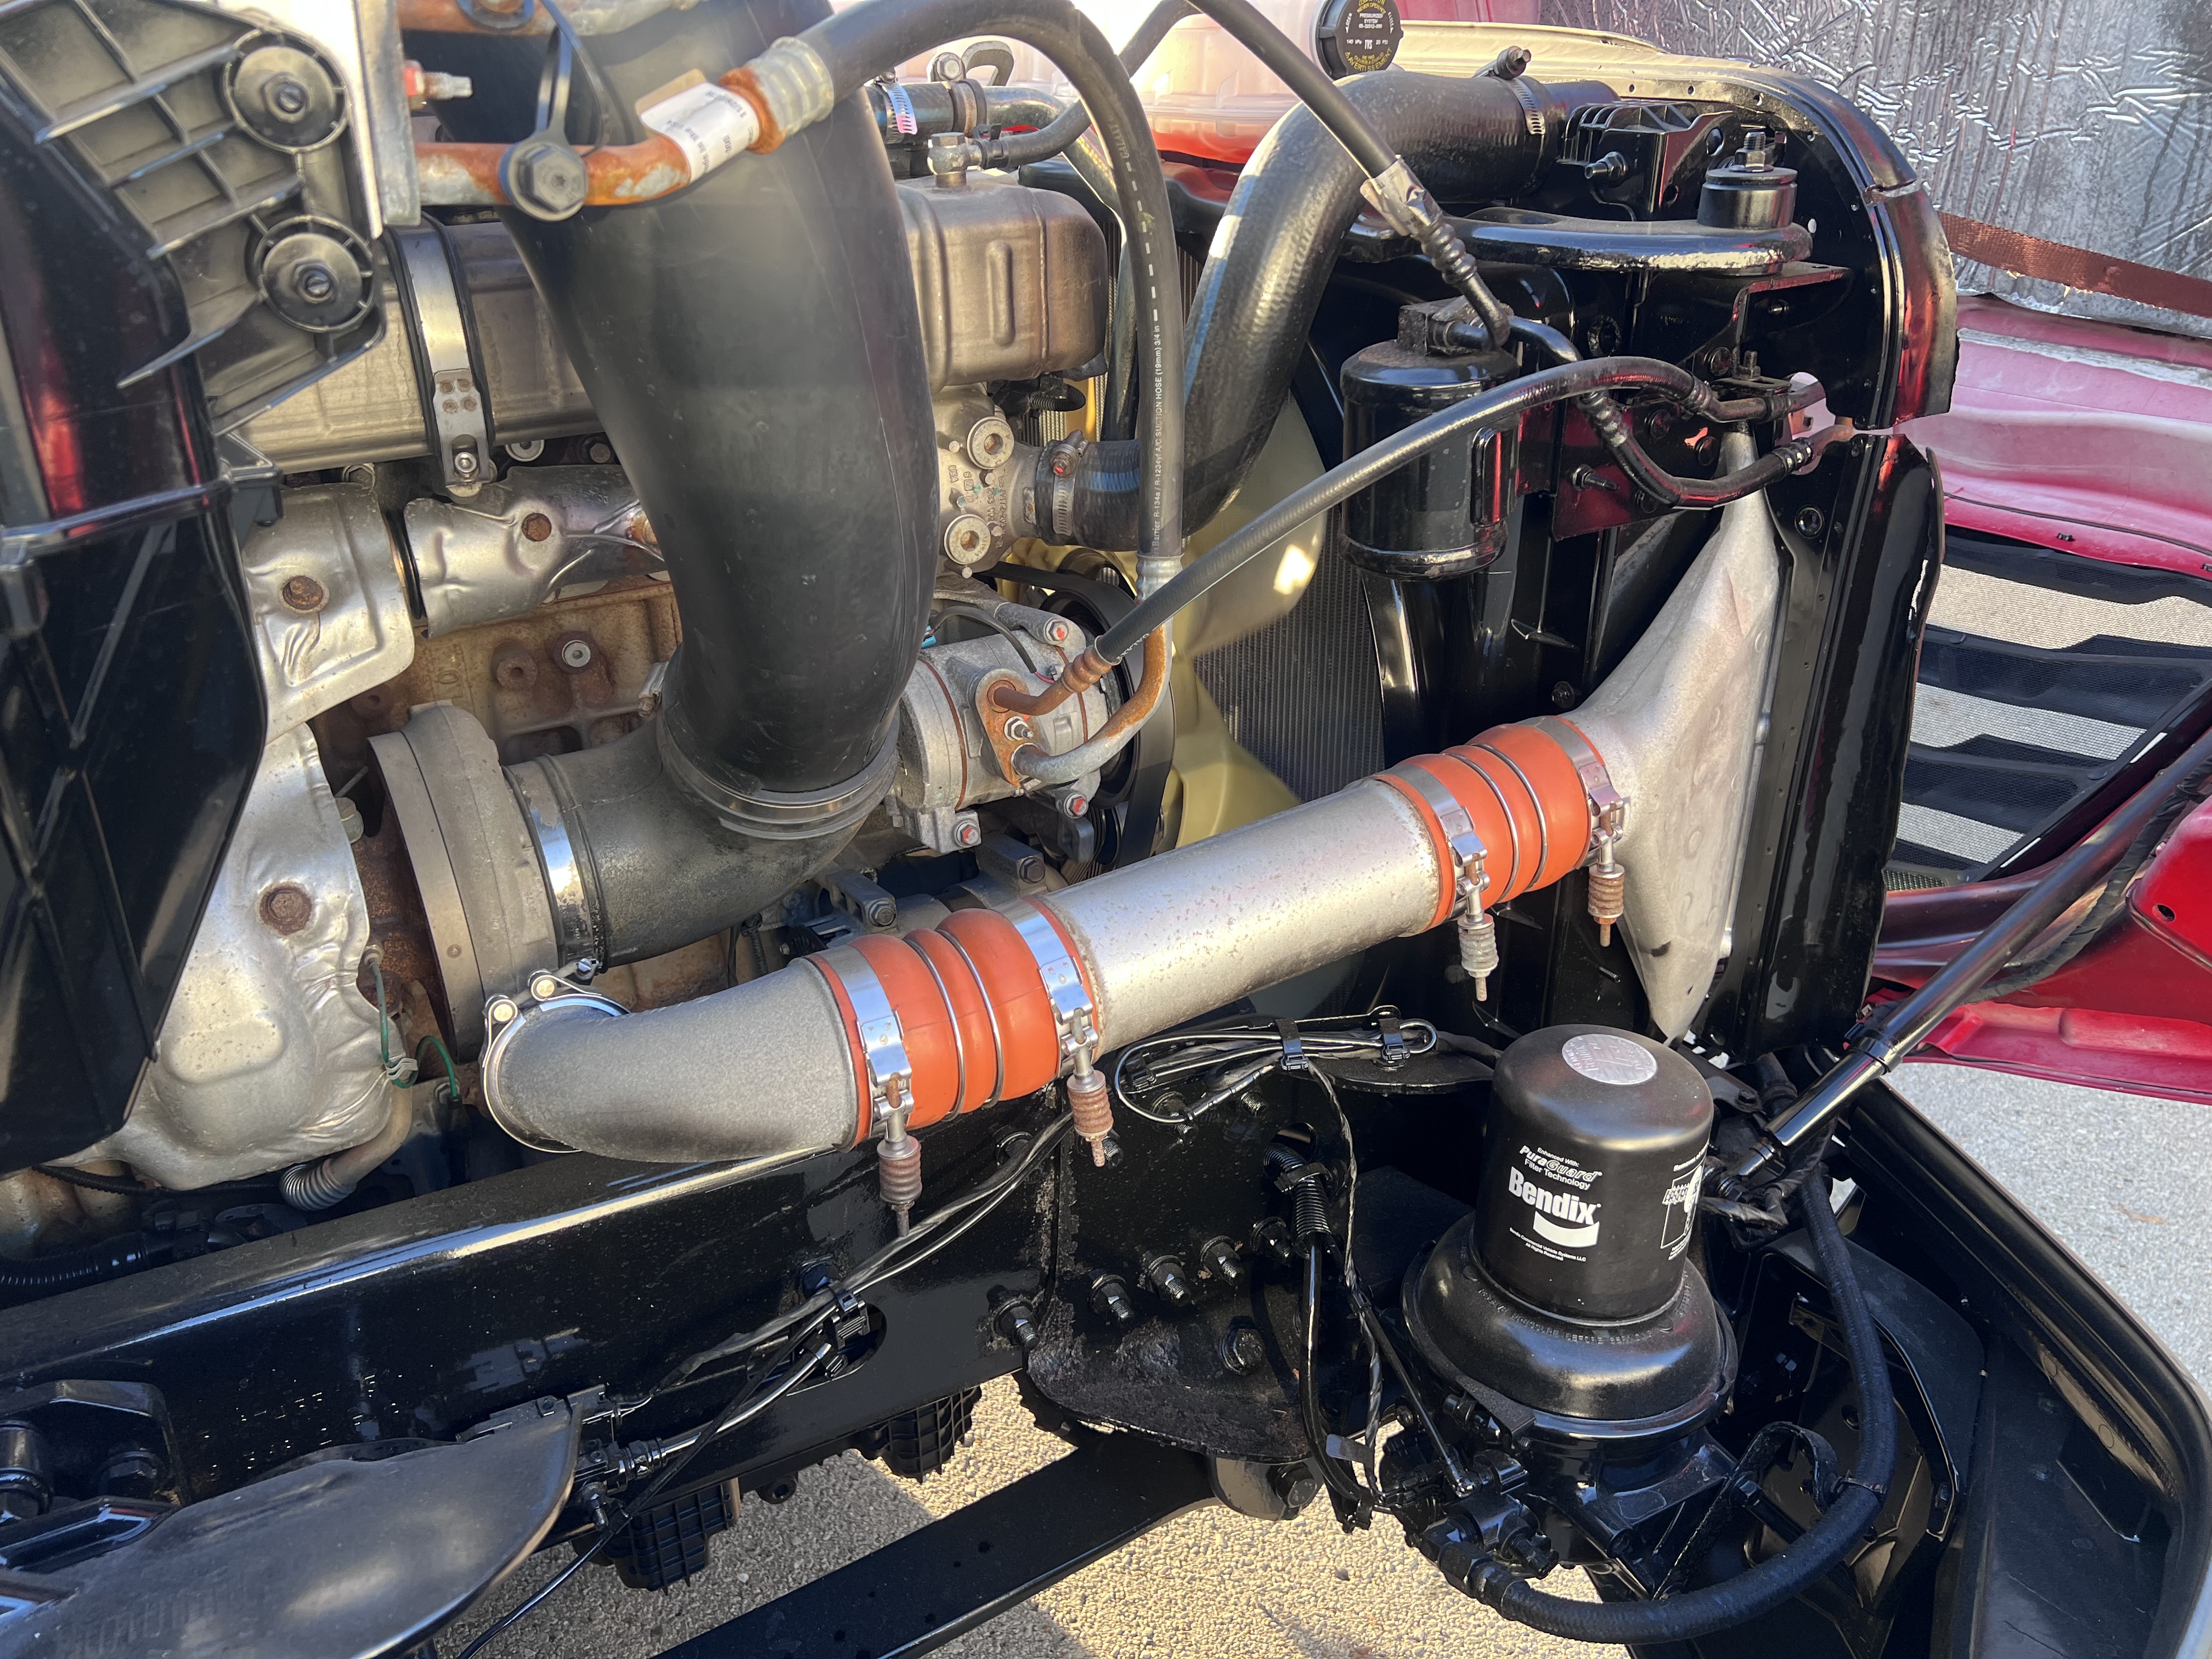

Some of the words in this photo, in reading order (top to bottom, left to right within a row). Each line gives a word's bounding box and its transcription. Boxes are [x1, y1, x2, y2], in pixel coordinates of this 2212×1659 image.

[1348, 47, 1392, 71] AVERTISSEMENT
[1154, 347, 1163, 375] (19mm)
[1537, 1147, 1564, 1162] Enhanced
[1565, 1158, 1580, 1167] With:
[1524, 1158, 1543, 1173] Filter
[1544, 1168, 1591, 1190] Technology
[1509, 1166, 1597, 1225] Bendix
[1521, 1235, 1543, 1249] Commercial
[1543, 1245, 1558, 1254] Vehicle
[1558, 1251, 1576, 1260] Systems
[1531, 1245, 1543, 1254] Rights
[1544, 1251, 1564, 1261] Reserved
[1511, 1313, 1559, 1338] PRESSURE
[1565, 1333, 1603, 1345] BEFORE
